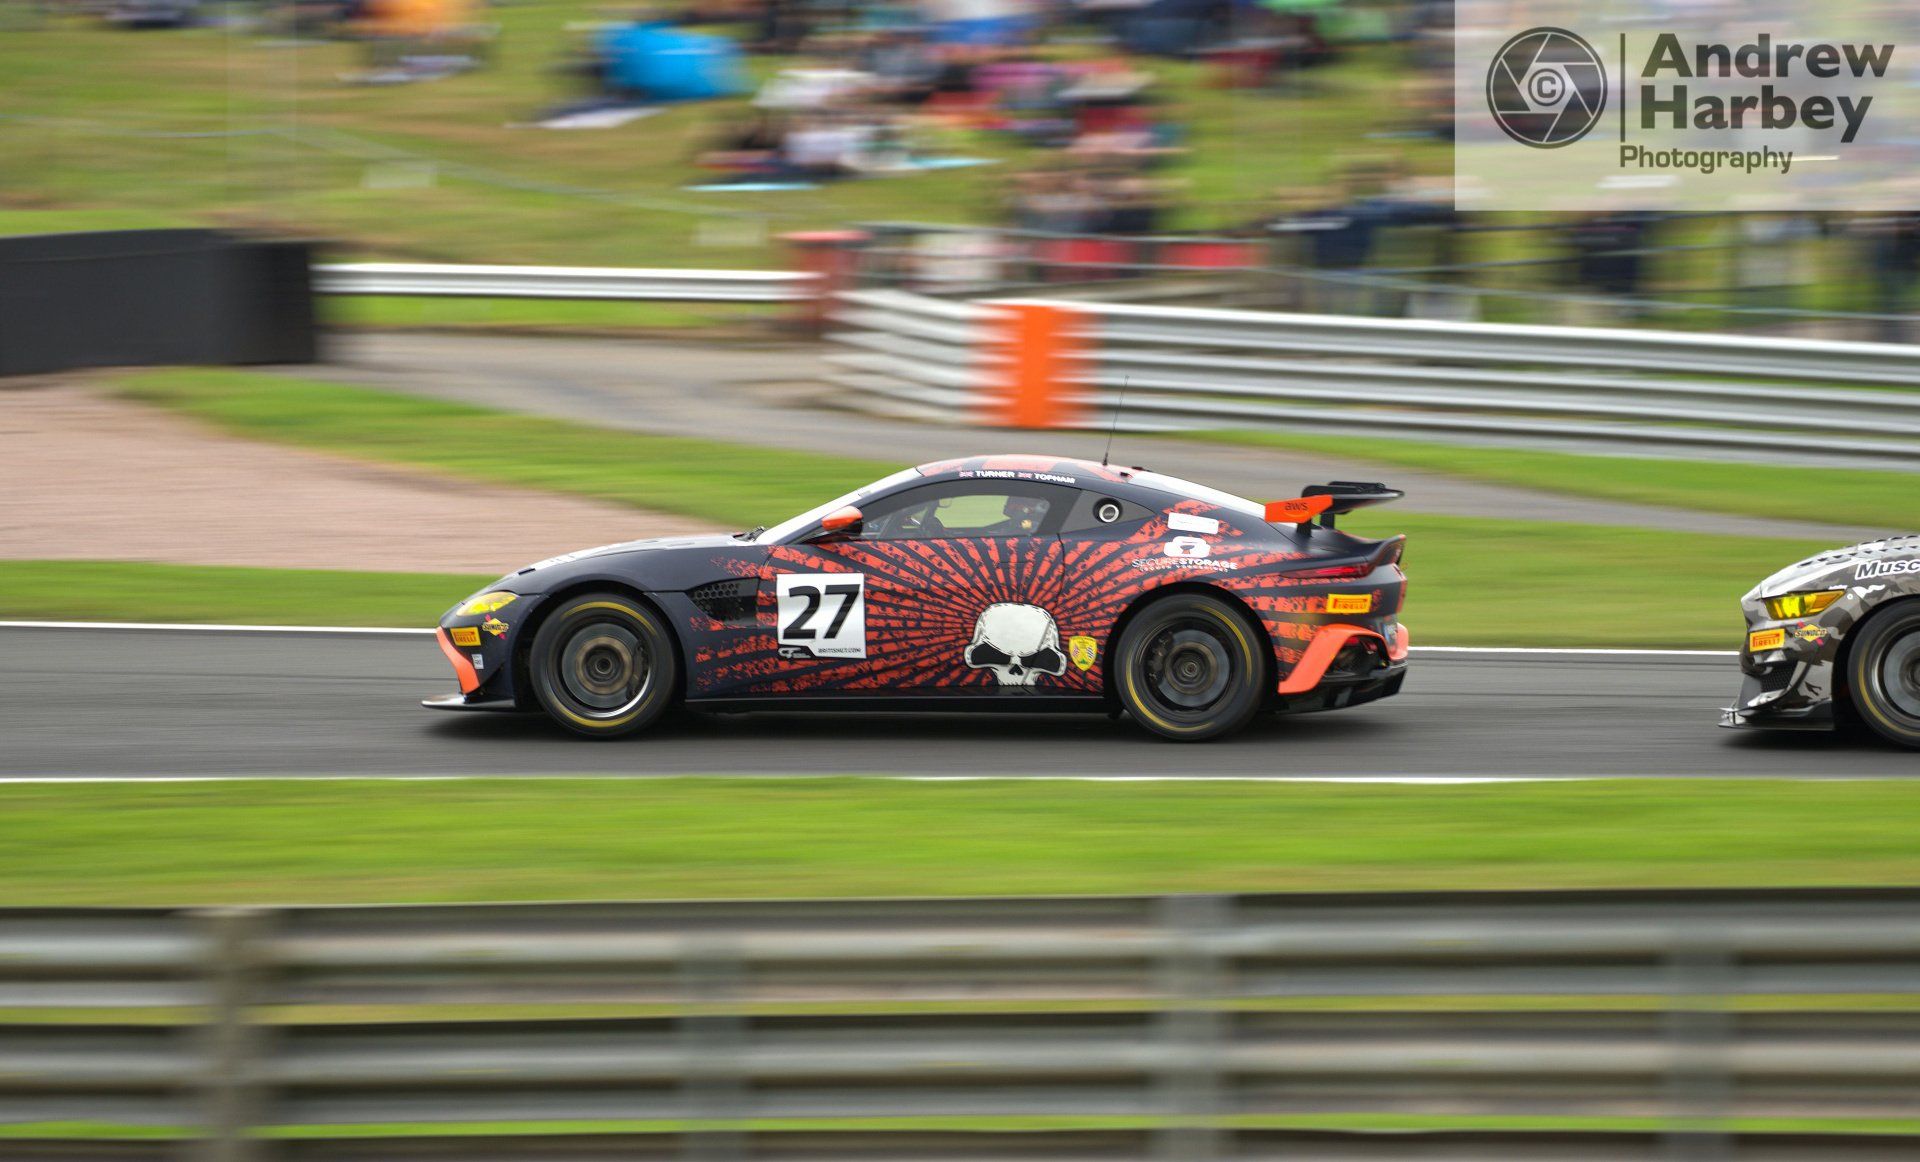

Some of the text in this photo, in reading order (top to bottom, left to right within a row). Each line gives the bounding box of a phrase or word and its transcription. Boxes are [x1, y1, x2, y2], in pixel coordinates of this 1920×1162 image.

[975, 470, 1015, 479] TURNER
[1034, 472, 1076, 485] TOPHAM
[1285, 502, 1309, 511] aws
[1333, 598, 1369, 610] PIRELLI
[783, 584, 860, 639] 27
[453, 631, 477, 643] PIRELLI
[1795, 628, 1827, 638] SUNOCO
[1752, 633, 1781, 648] PIRELLI
